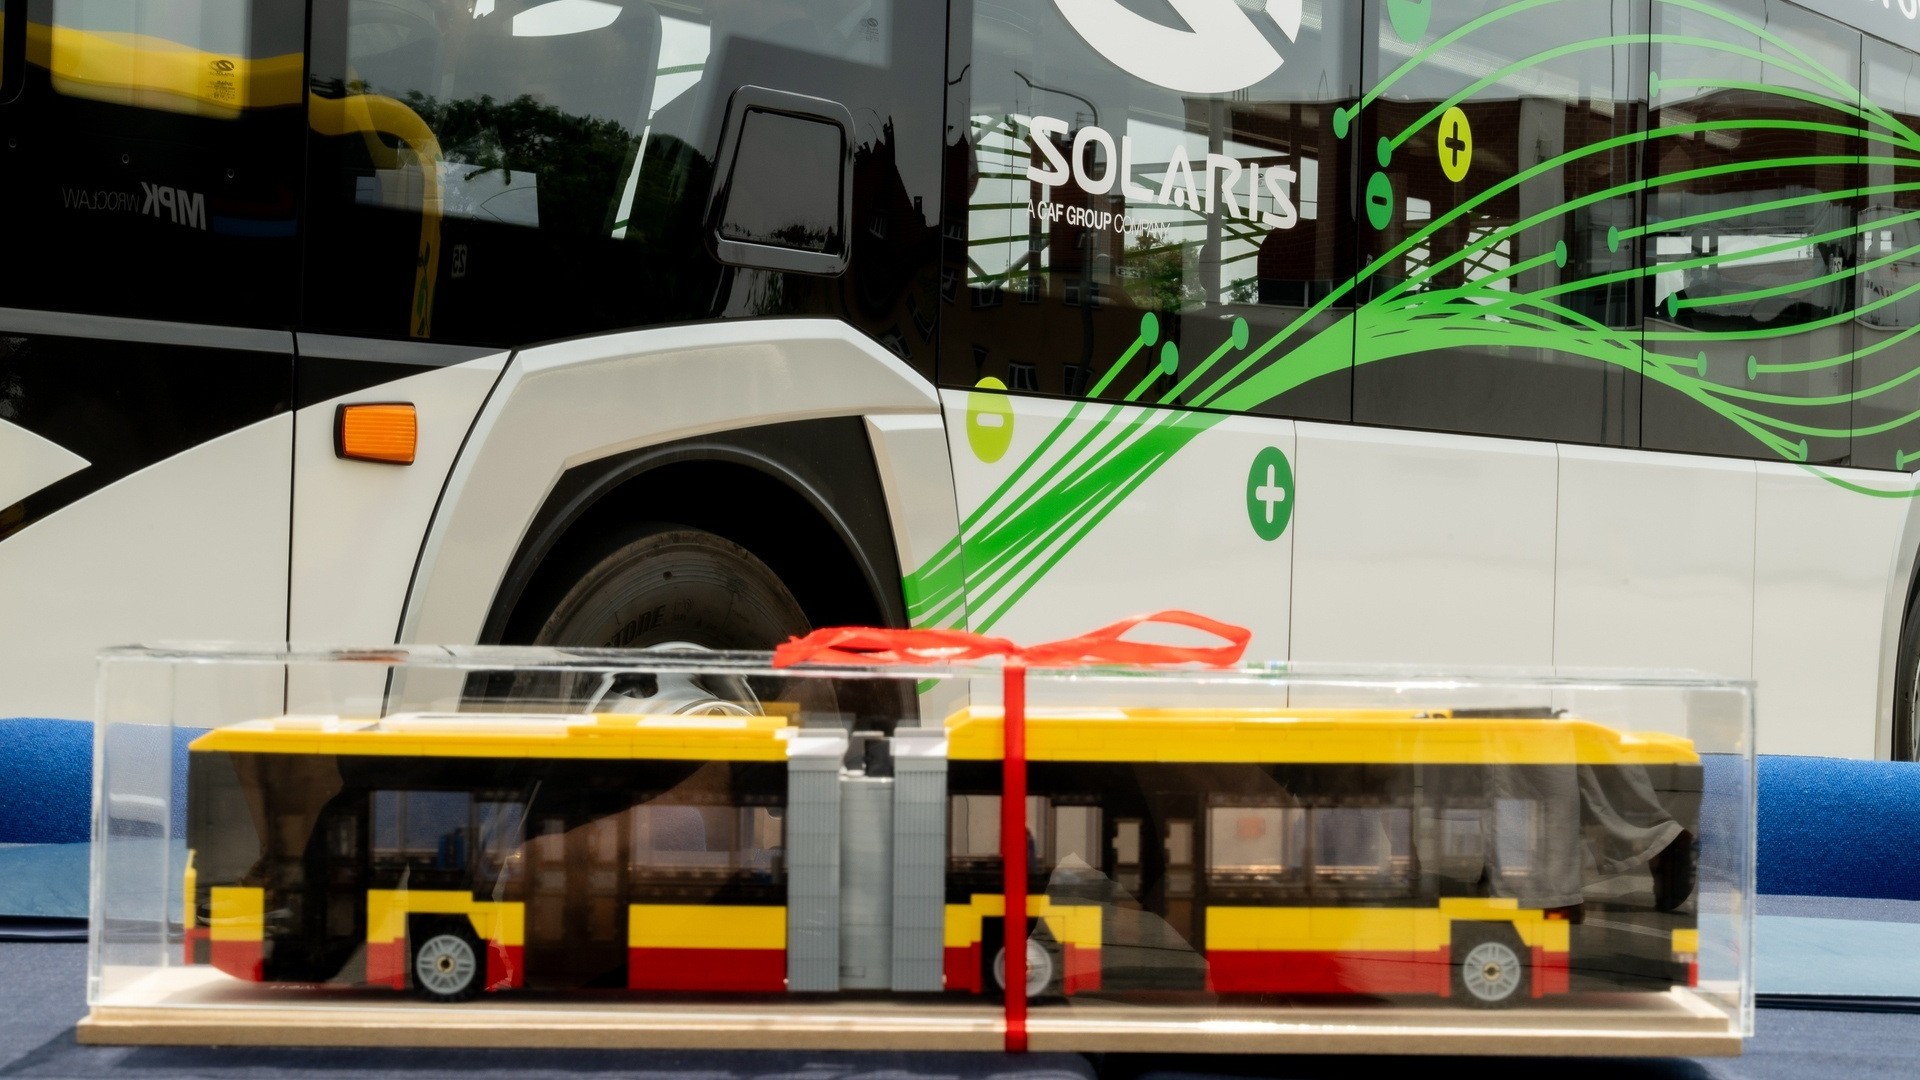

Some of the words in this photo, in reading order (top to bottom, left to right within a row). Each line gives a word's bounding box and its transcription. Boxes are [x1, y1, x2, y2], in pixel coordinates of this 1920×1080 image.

[1026, 115, 1298, 230] SOLARIS
[1026, 198, 1036, 219] A
[1037, 201, 1064, 222] CAF
[1066, 205, 1112, 231] GROUP
[1113, 213, 1171, 240] COMPANY
